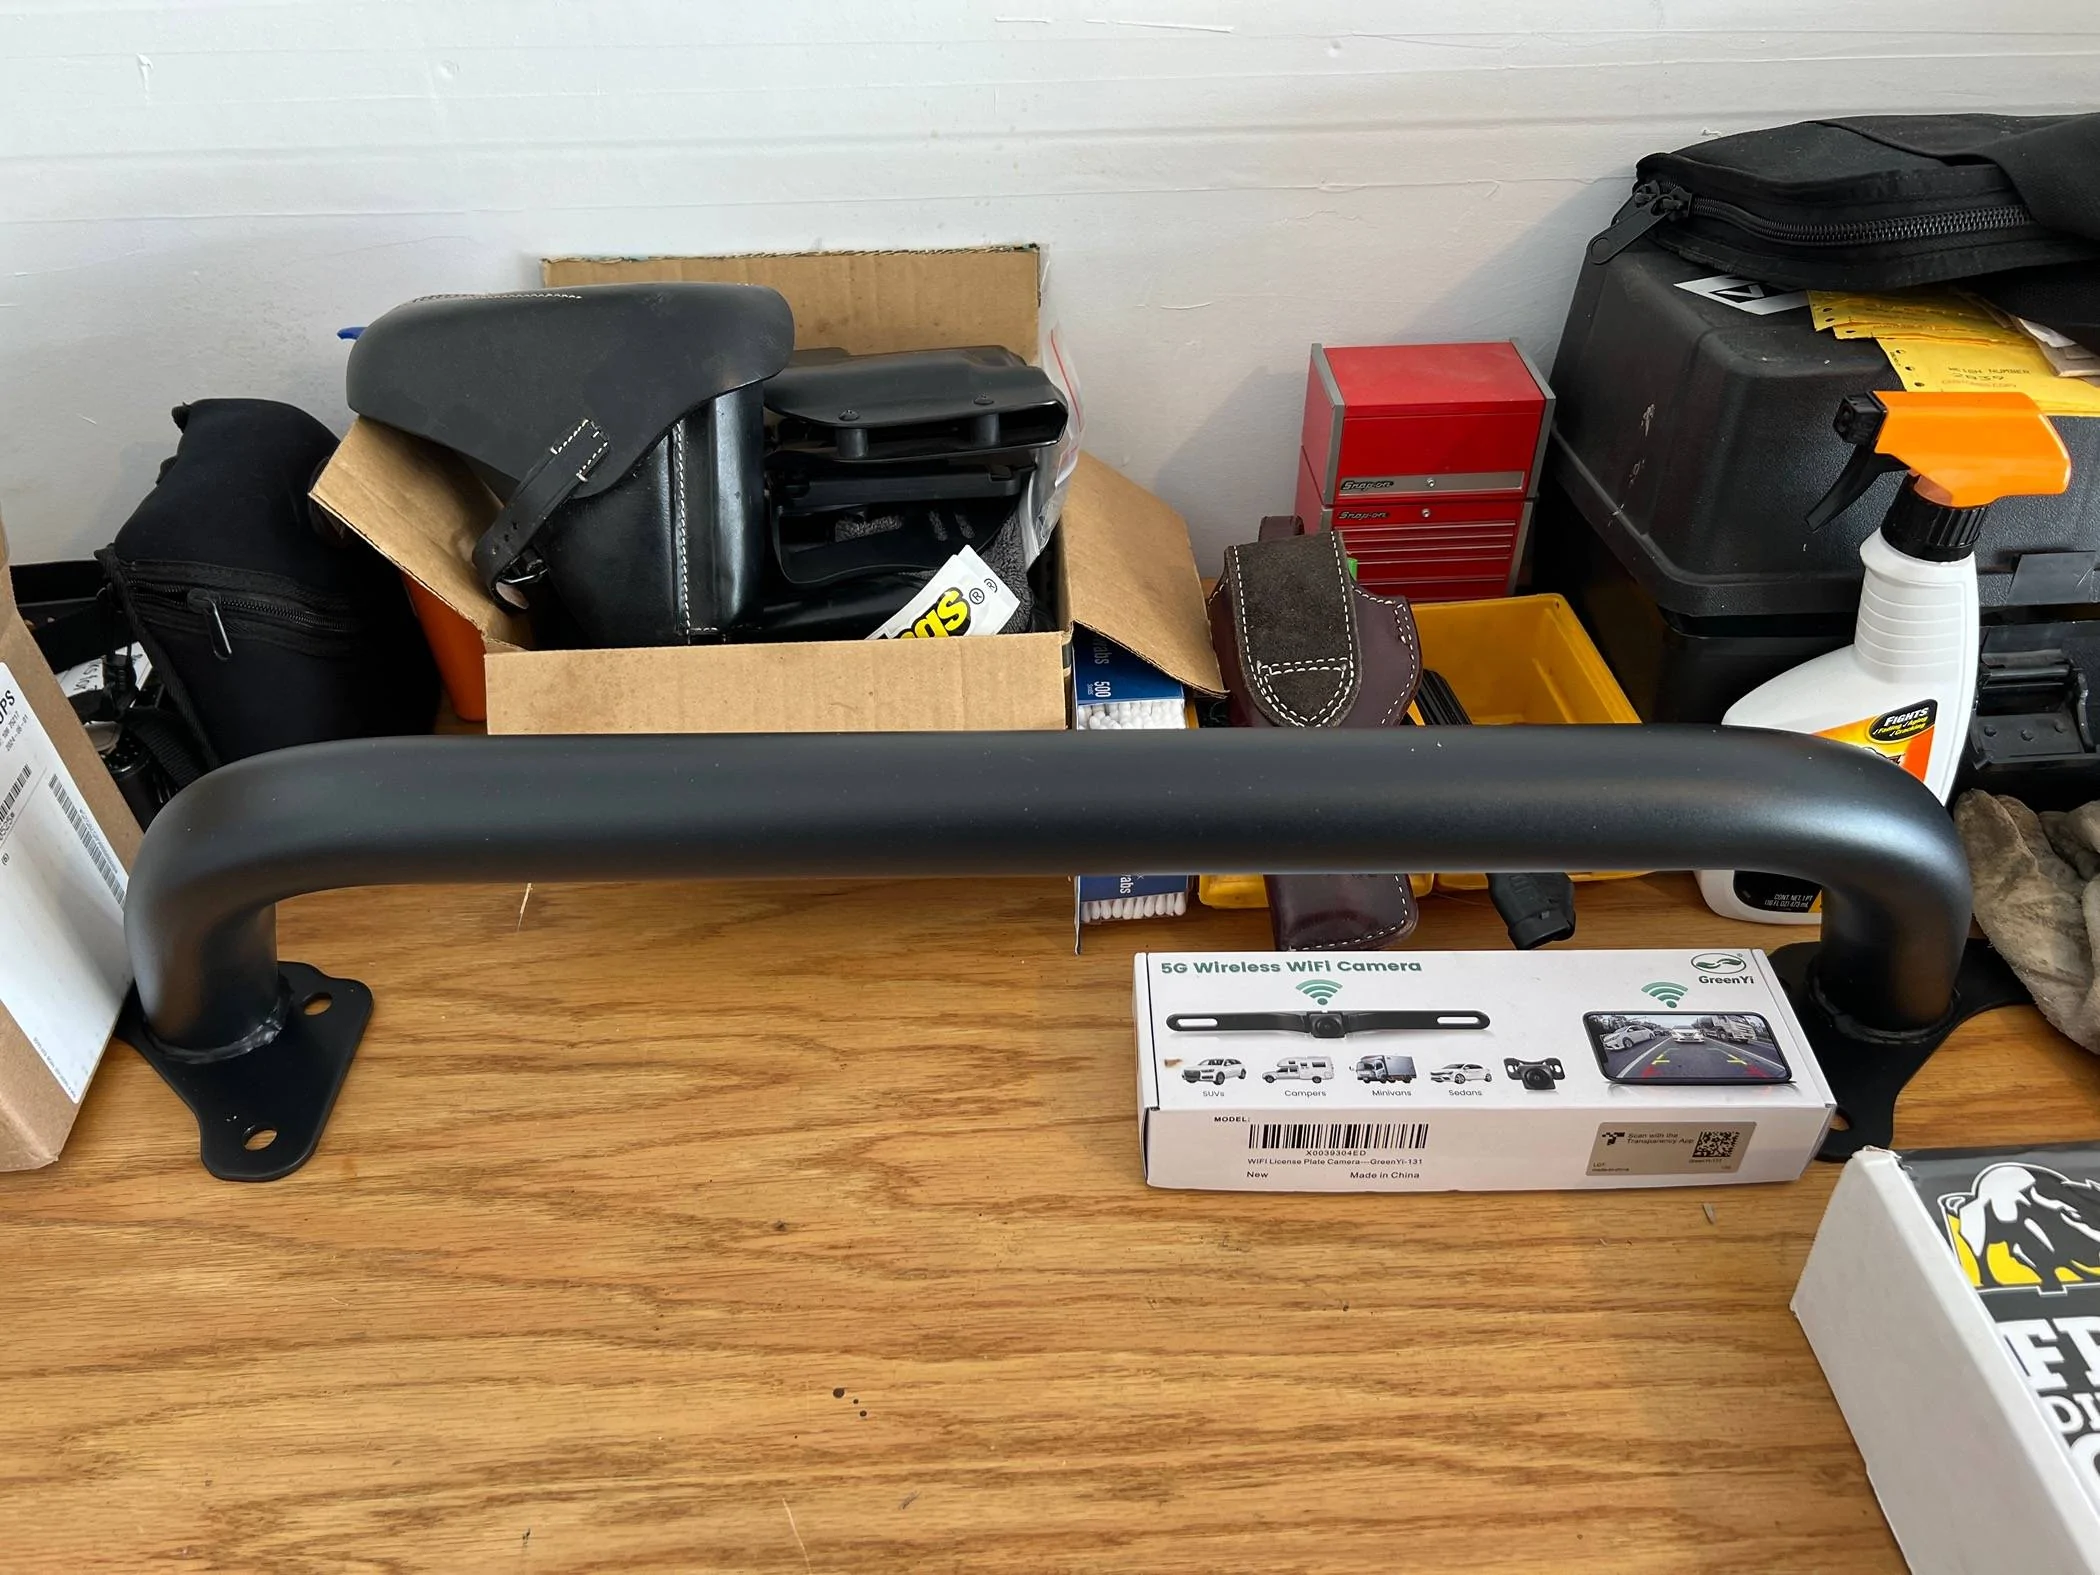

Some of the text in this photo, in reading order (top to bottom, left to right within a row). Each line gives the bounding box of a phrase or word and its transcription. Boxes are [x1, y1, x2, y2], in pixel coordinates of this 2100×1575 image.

[1094, 681, 1111, 698] 500
[1883, 706, 1930, 727] FIGHTS
[1877, 723, 1903, 734] Fading
[1894, 723, 1926, 736] Cracking
[1161, 962, 1188, 974] 5G
[1193, 961, 1281, 974] Wireless
[1336, 960, 1422, 972] Camera
[1698, 975, 1755, 984] GreenYi
[1202, 1090, 1225, 1098] SUVs
[1284, 1089, 1327, 1099] Campers
[1372, 1089, 1412, 1097] Minivans
[1448, 1089, 1483, 1097] Sedans
